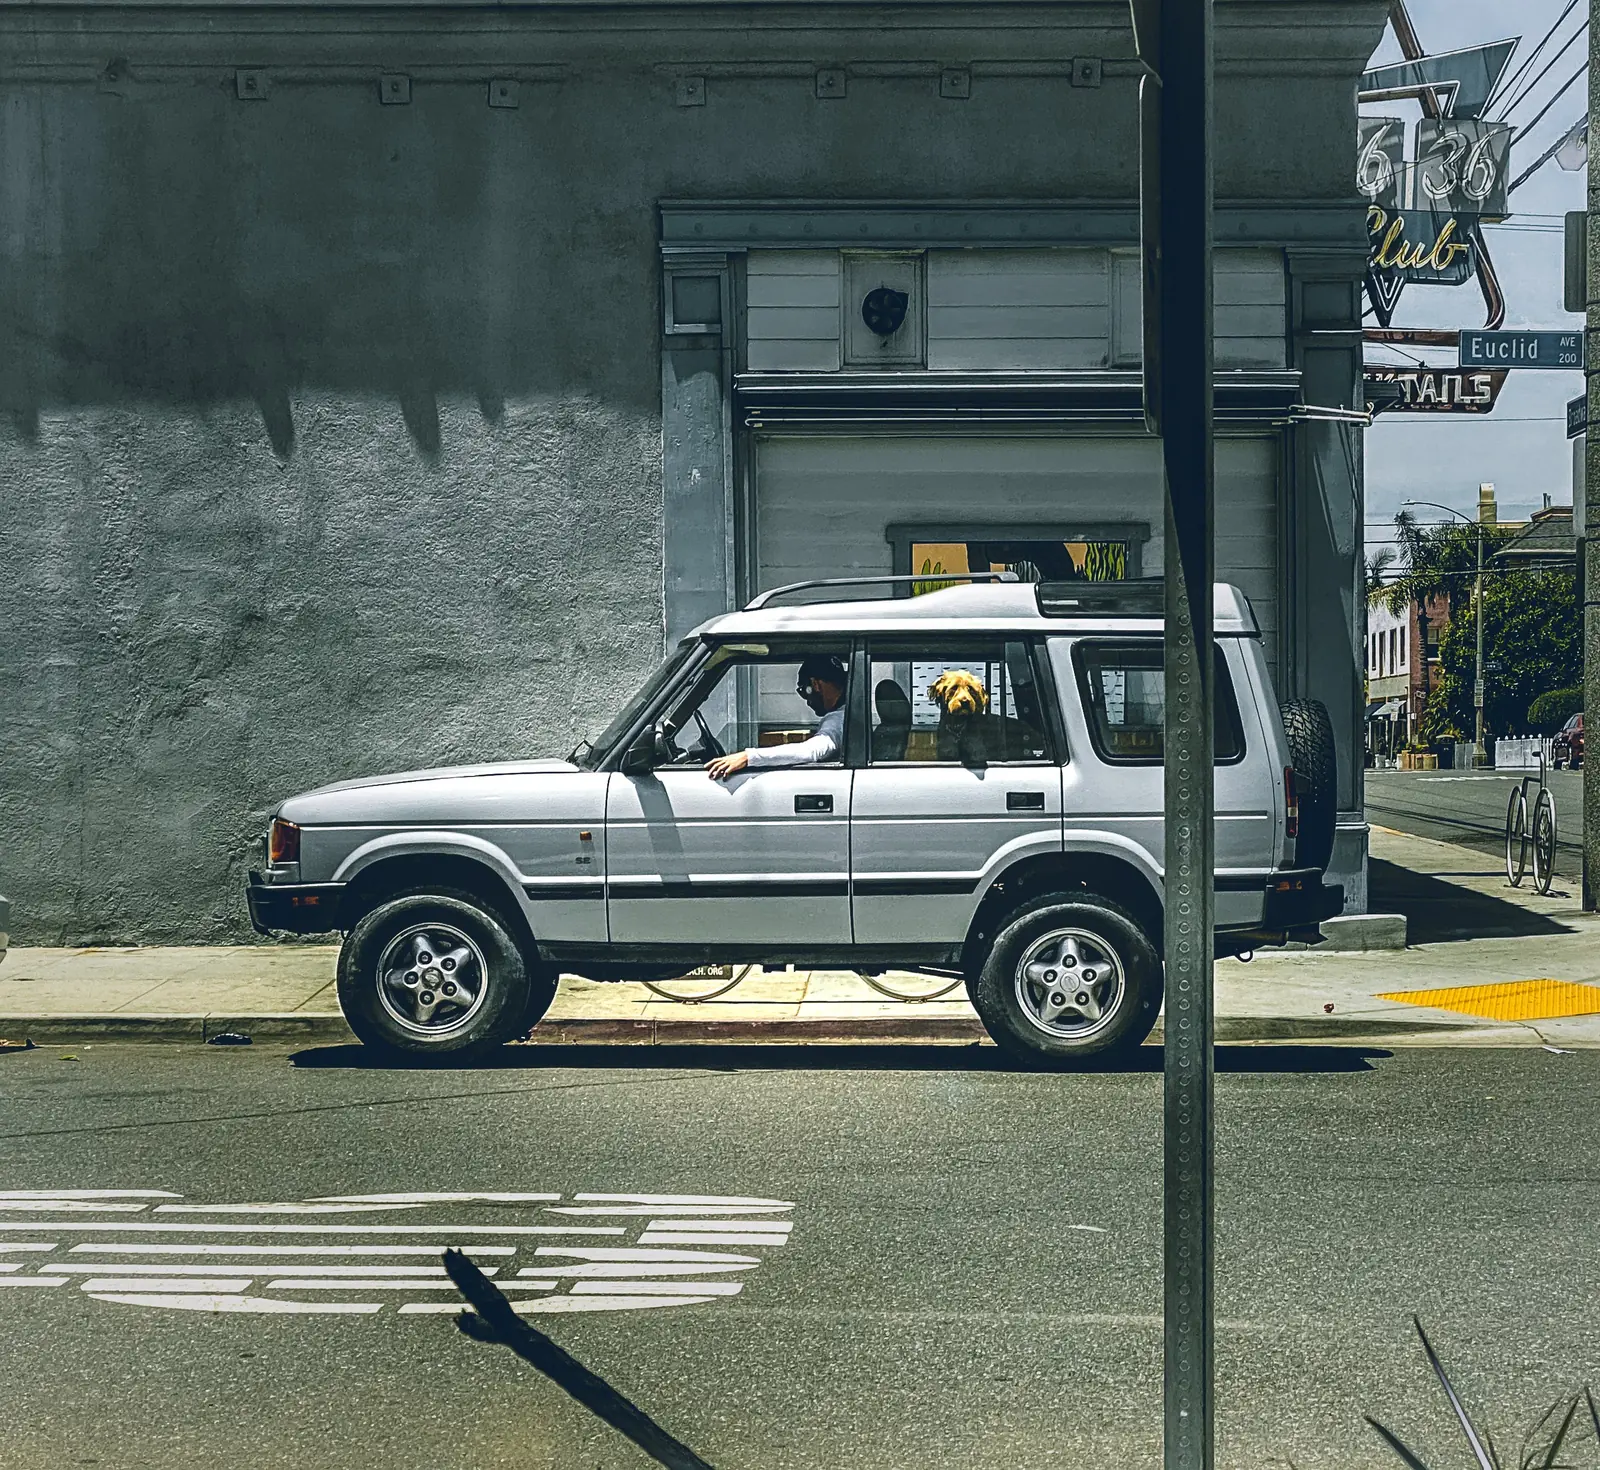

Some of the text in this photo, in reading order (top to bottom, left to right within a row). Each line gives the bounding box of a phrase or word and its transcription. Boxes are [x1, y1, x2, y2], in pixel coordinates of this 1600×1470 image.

[1472, 338, 1538, 359] Euclid
[1560, 337, 1576, 347] AVE
[1559, 353, 1577, 363] 200
[1363, 373, 1491, 404] TAILS
